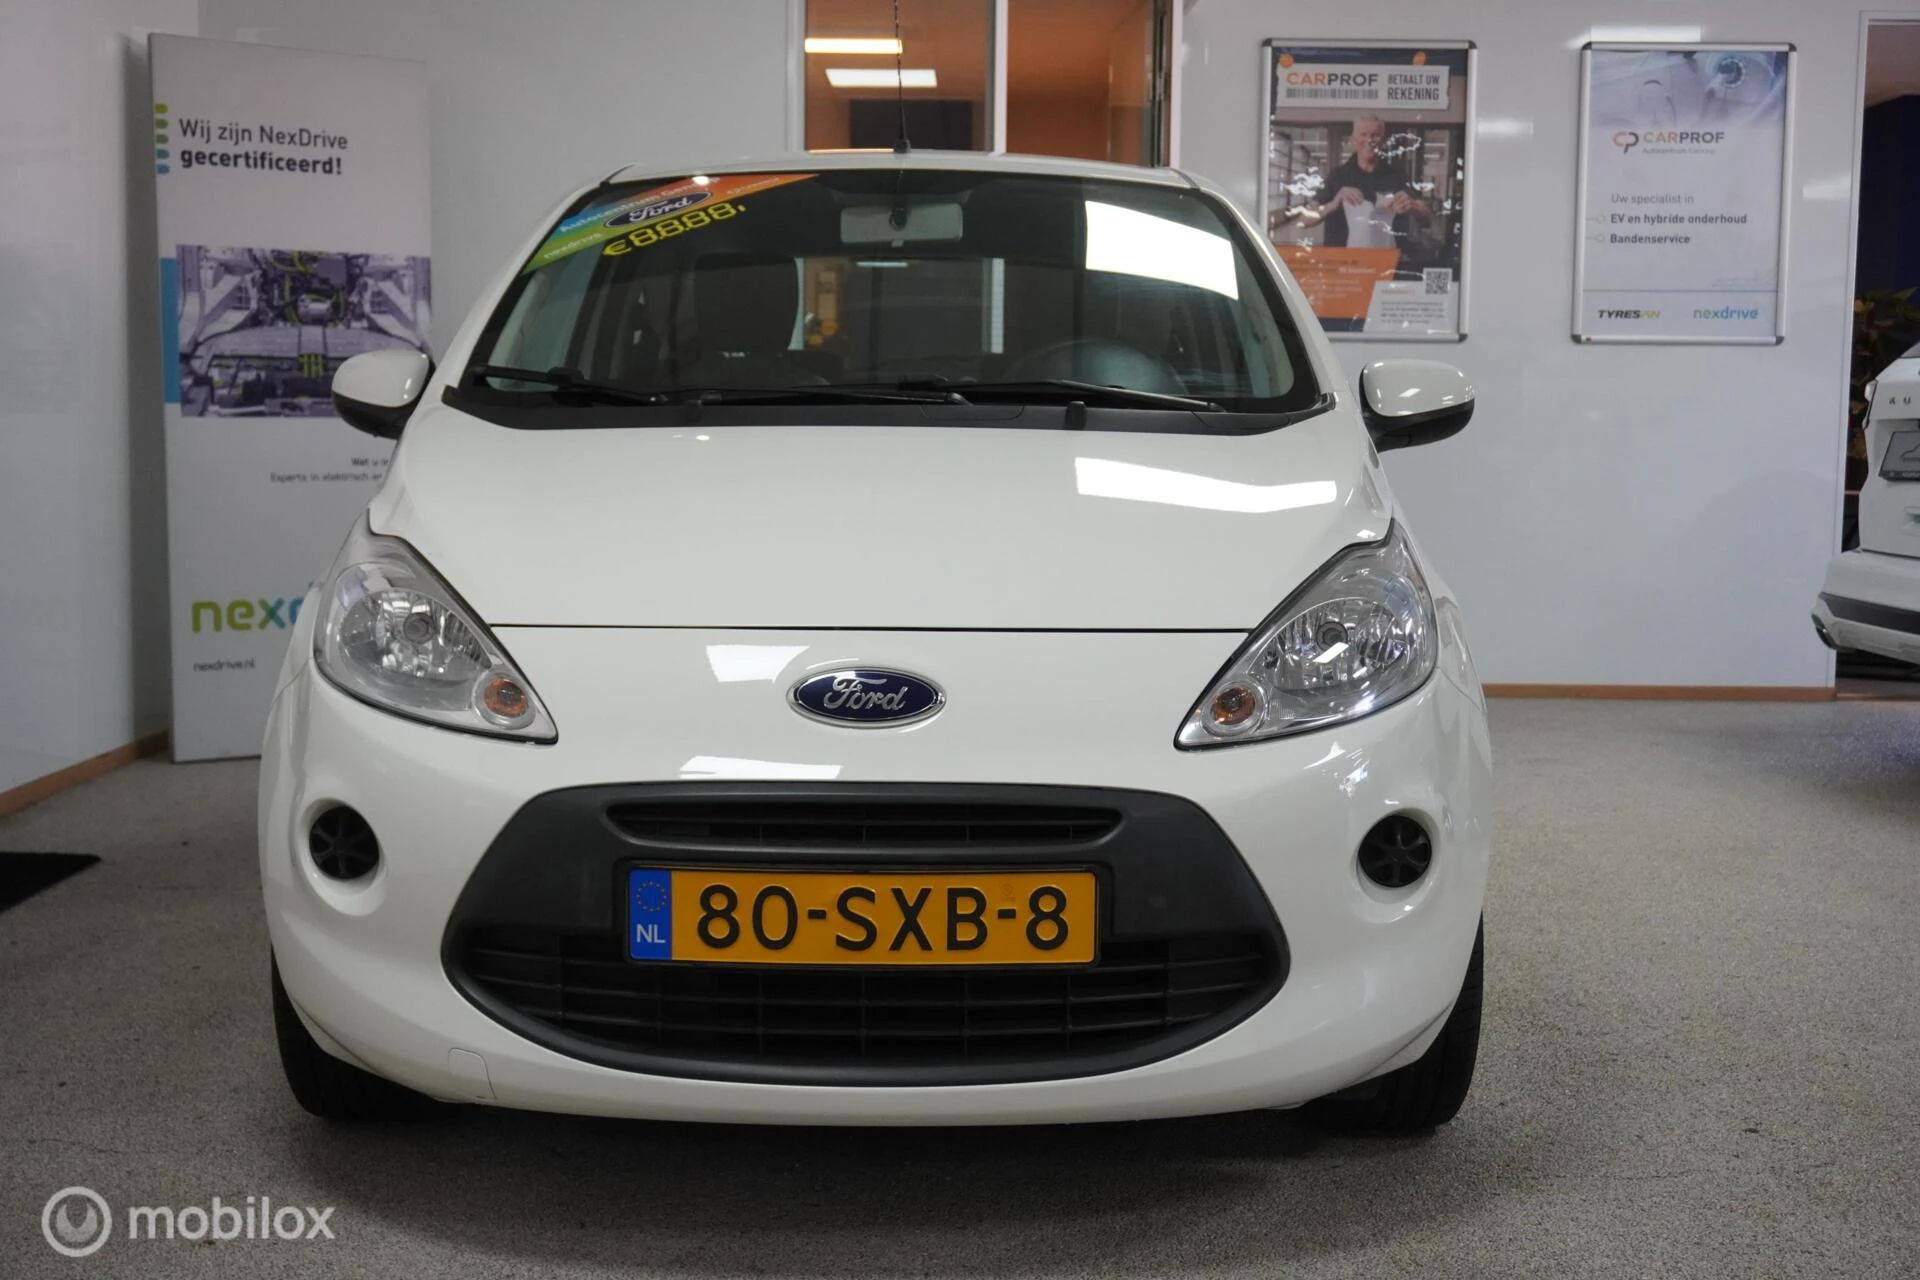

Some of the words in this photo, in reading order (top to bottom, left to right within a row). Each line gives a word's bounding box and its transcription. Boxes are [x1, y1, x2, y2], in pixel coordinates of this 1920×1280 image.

[1286, 72, 1378, 86] CARPROF
[1388, 73, 1423, 85] BETAALT
[1426, 74, 1440, 85] UW
[1388, 87, 1440, 100] REKENING
[179, 117, 211, 144] Wij
[218, 121, 252, 146] zijn
[260, 124, 349, 150] NexDrive
[1643, 131, 1725, 144] CARPROF
[180, 149, 342, 175] gecertificeerd!
[1611, 193, 1628, 204] Uw
[1631, 193, 1681, 205] specialist
[1684, 193, 1694, 204] in
[629, 197, 692, 222] Ford
[1611, 213, 1625, 223] EV
[1627, 215, 1640, 223] en
[1644, 213, 1685, 225] hybride
[1688, 213, 1747, 224] onderhoud
[1610, 233, 1690, 244] Bandenservice
[1693, 304, 1759, 320] nexdrive
[823, 674, 908, 710] Ford
[696, 883, 1069, 952] 80-SXB-8
[636, 924, 666, 944] NL
